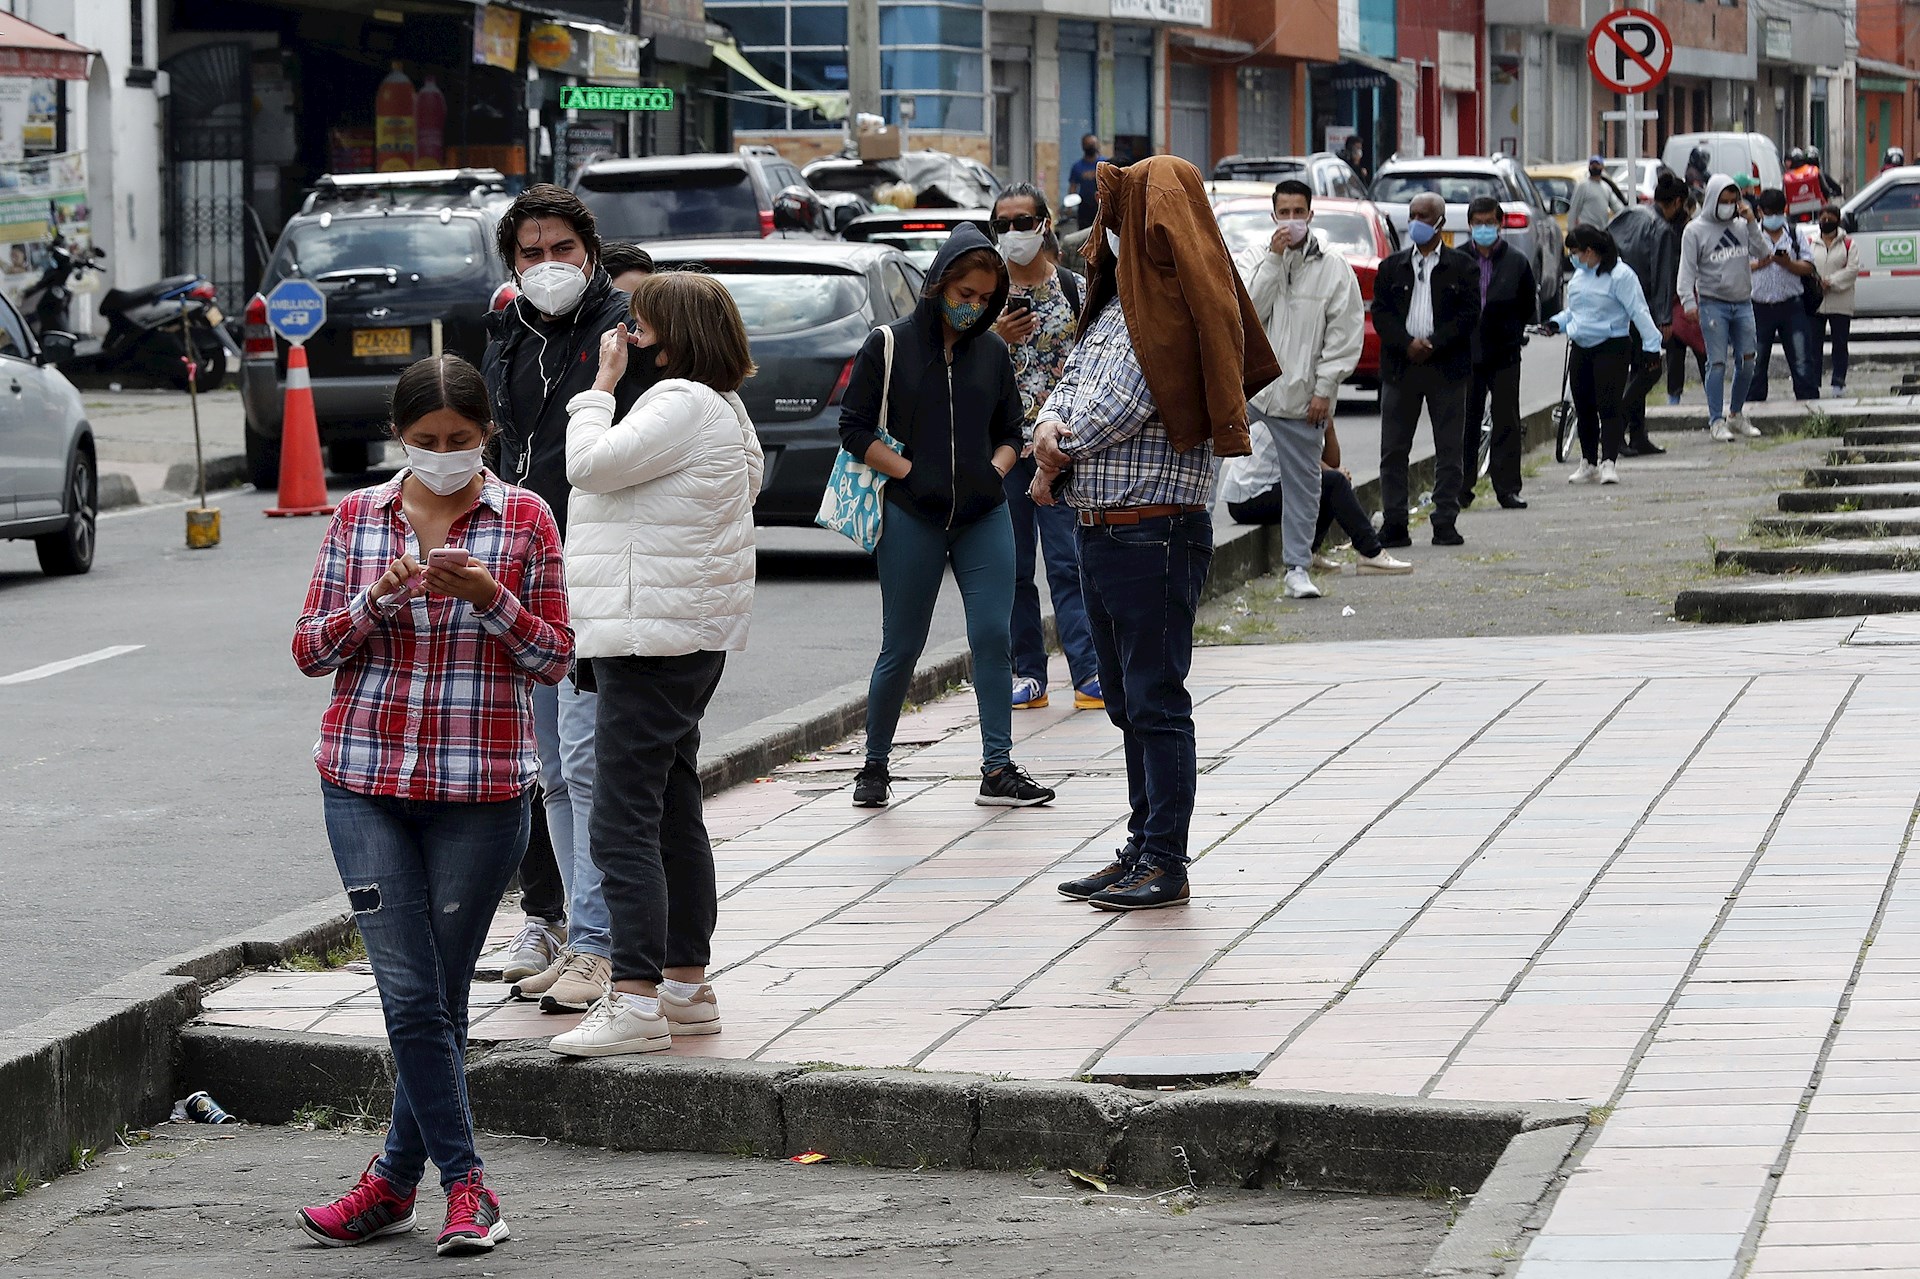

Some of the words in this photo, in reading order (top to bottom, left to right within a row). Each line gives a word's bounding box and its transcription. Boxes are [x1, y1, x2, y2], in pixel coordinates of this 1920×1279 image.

[1615, 23, 1656, 81] P
[1710, 245, 1749, 262] adidas
[271, 299, 321, 311] AMBULANCIA
